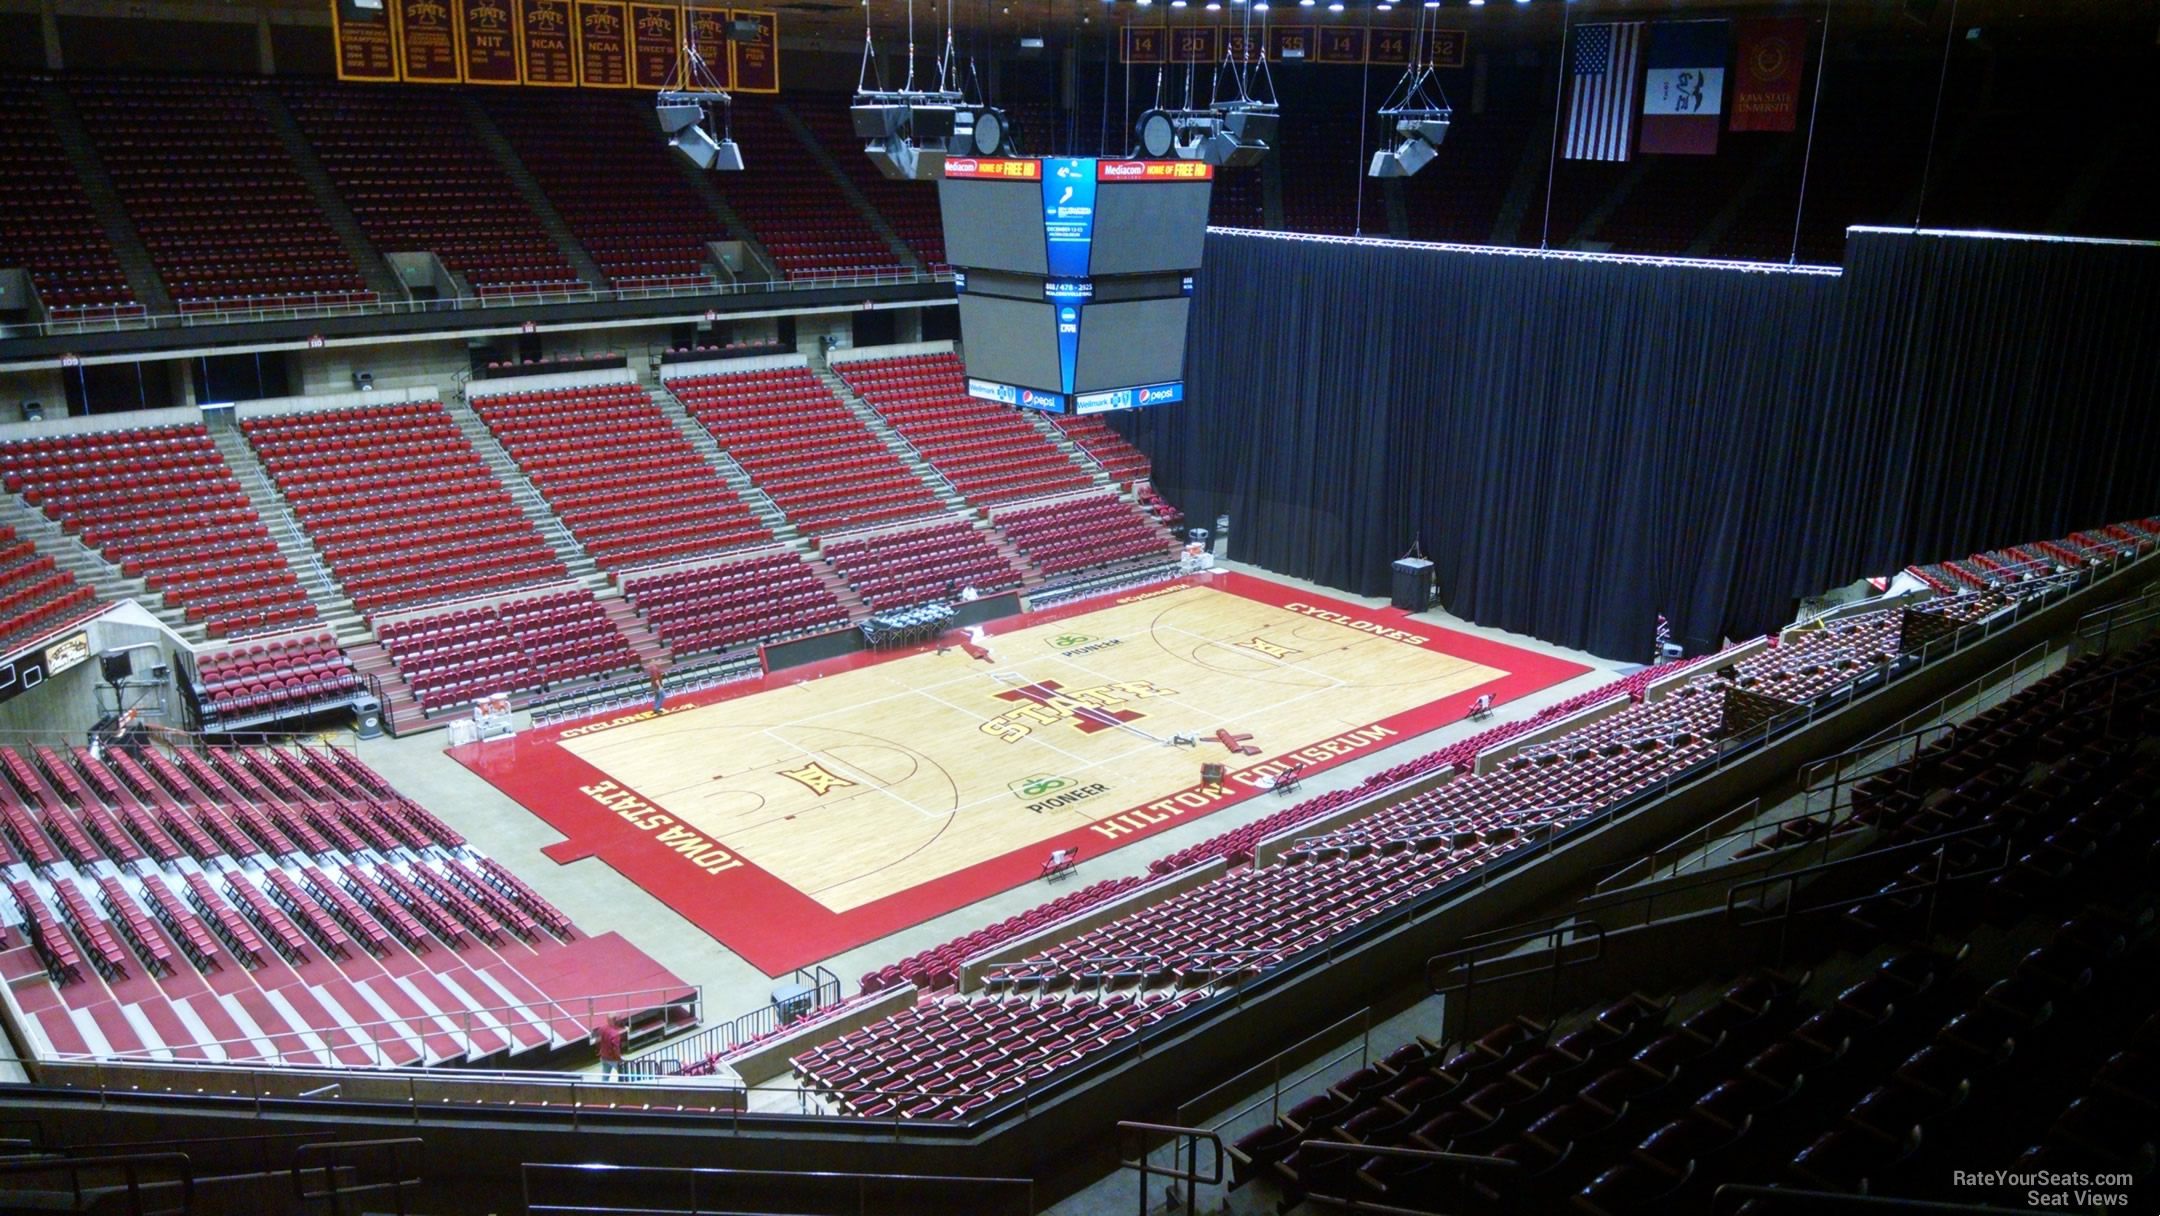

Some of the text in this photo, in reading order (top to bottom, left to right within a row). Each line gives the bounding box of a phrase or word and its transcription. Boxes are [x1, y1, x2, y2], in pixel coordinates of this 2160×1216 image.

[528, 10, 565, 25] STATE
[585, 13, 621, 28] STATE
[639, 16, 672, 31] STATE
[476, 35, 503, 48] NIT
[531, 39, 565, 49] NCAA
[587, 41, 619, 52] NCAA
[1134, 37, 1152, 51] 14
[1181, 37, 1204, 51] 20
[1332, 37, 1351, 51] 14
[1379, 38, 1403, 53] 44
[1004, 161, 1022, 175] FREE
[1105, 163, 1206, 176] Mediacom HOME OF FREE HD
[969, 384, 1055, 408] Wellmark pepsi
[1077, 389, 1173, 409] Wellmark pepsi
[1283, 602, 1431, 646] CYCLONES
[1062, 639, 1123, 657] PIONEER
[979, 679, 1180, 744] STATE
[1089, 724, 1398, 840] HILTON COLISEUM
[1025, 782, 1111, 814] PIONEER
[579, 779, 745, 875] IOWA STATE
